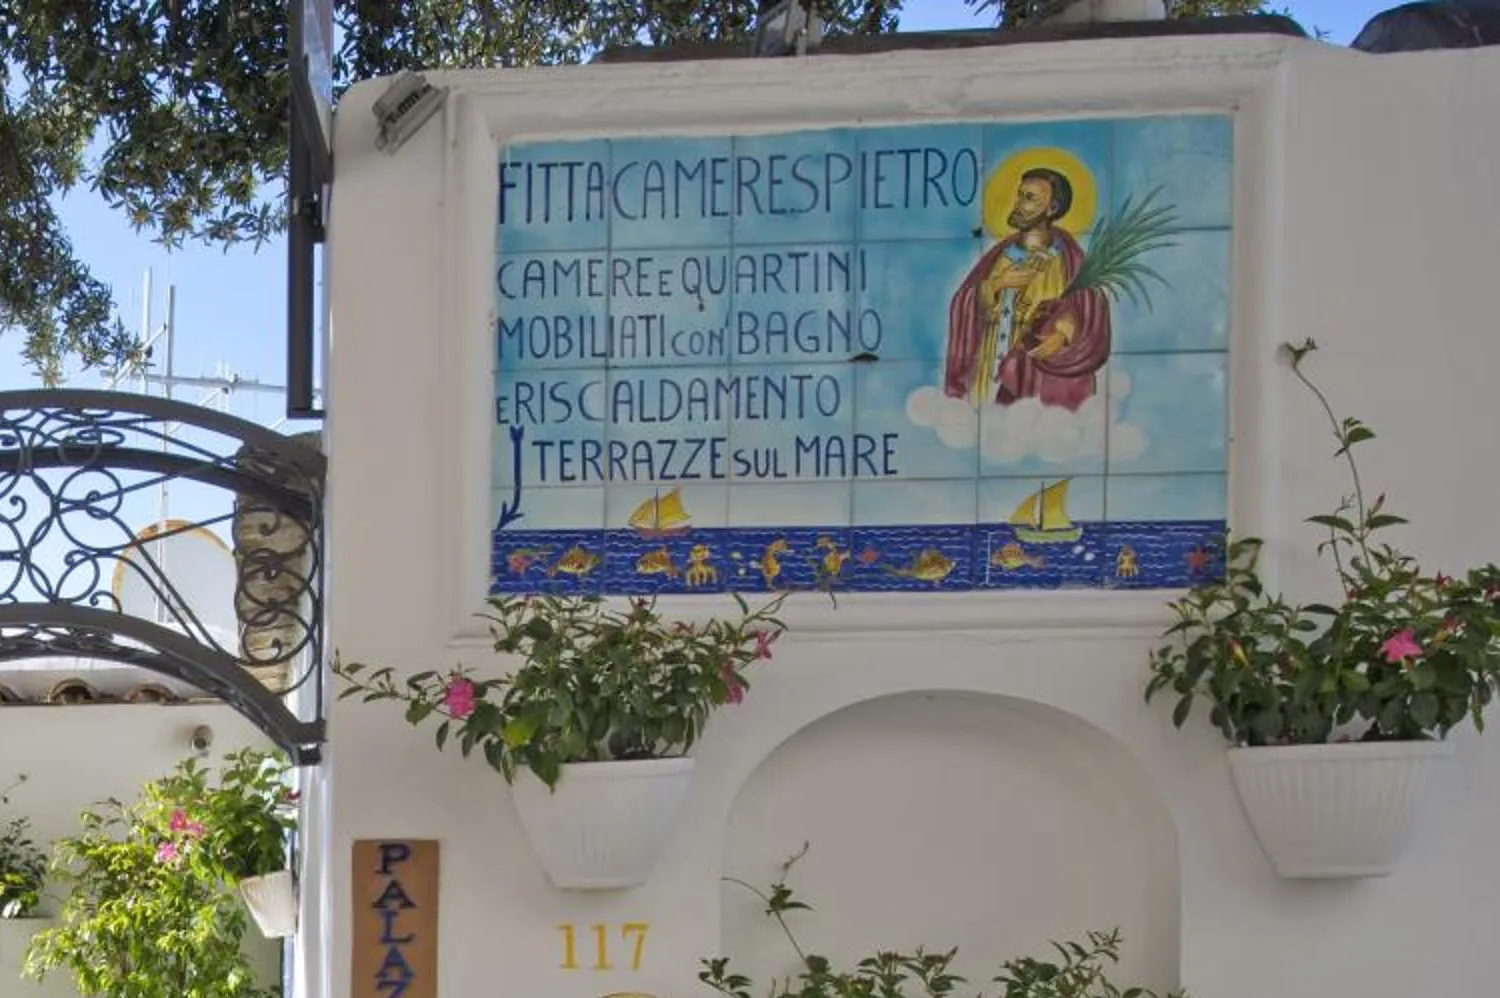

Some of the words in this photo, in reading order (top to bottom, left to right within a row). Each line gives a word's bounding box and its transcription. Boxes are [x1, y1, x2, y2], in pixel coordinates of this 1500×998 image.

[682, 249, 867, 297] QUARTINI
[497, 314, 666, 360] MOBILIATI
[737, 308, 883, 355] BAGNO
[515, 375, 841, 425] RISCALDAMENTO
[531, 437, 727, 482] TERRAZZE
[794, 433, 899, 478] MARE
[556, 922, 651, 971] 117
